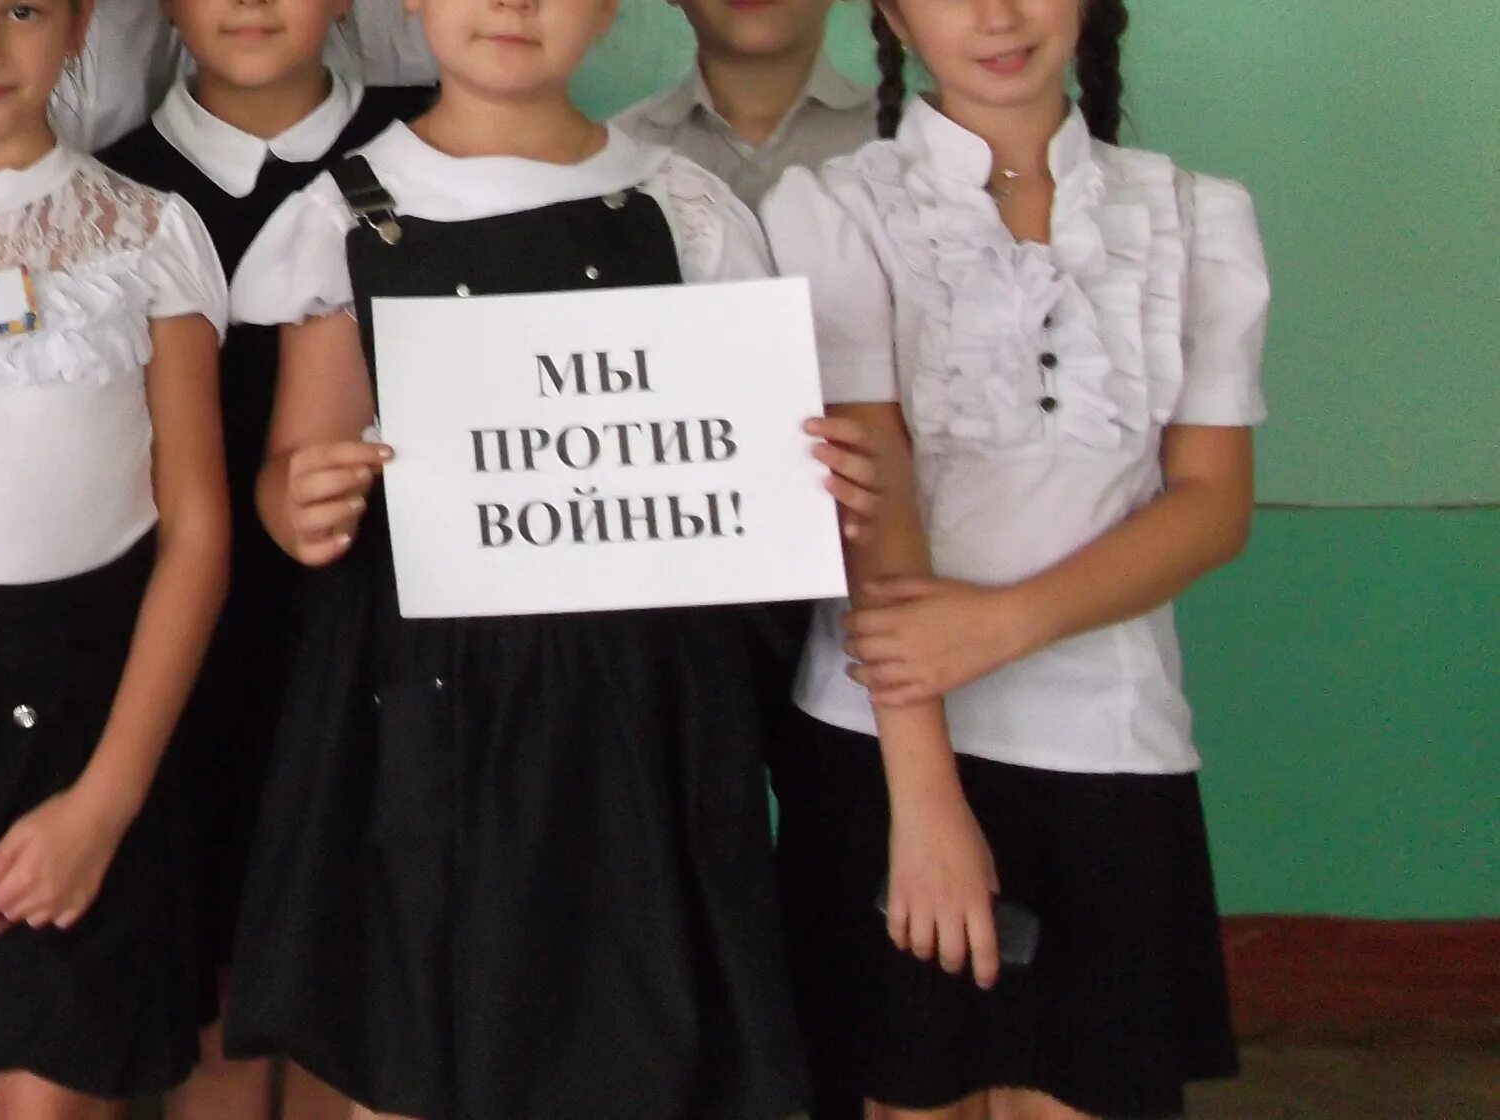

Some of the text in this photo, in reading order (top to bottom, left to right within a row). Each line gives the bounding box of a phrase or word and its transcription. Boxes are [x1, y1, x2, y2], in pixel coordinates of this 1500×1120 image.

[535, 349, 651, 397] МЫ
[470, 418, 738, 473] ПРОТИВ
[476, 486, 745, 548] ВОЙНЫ!
